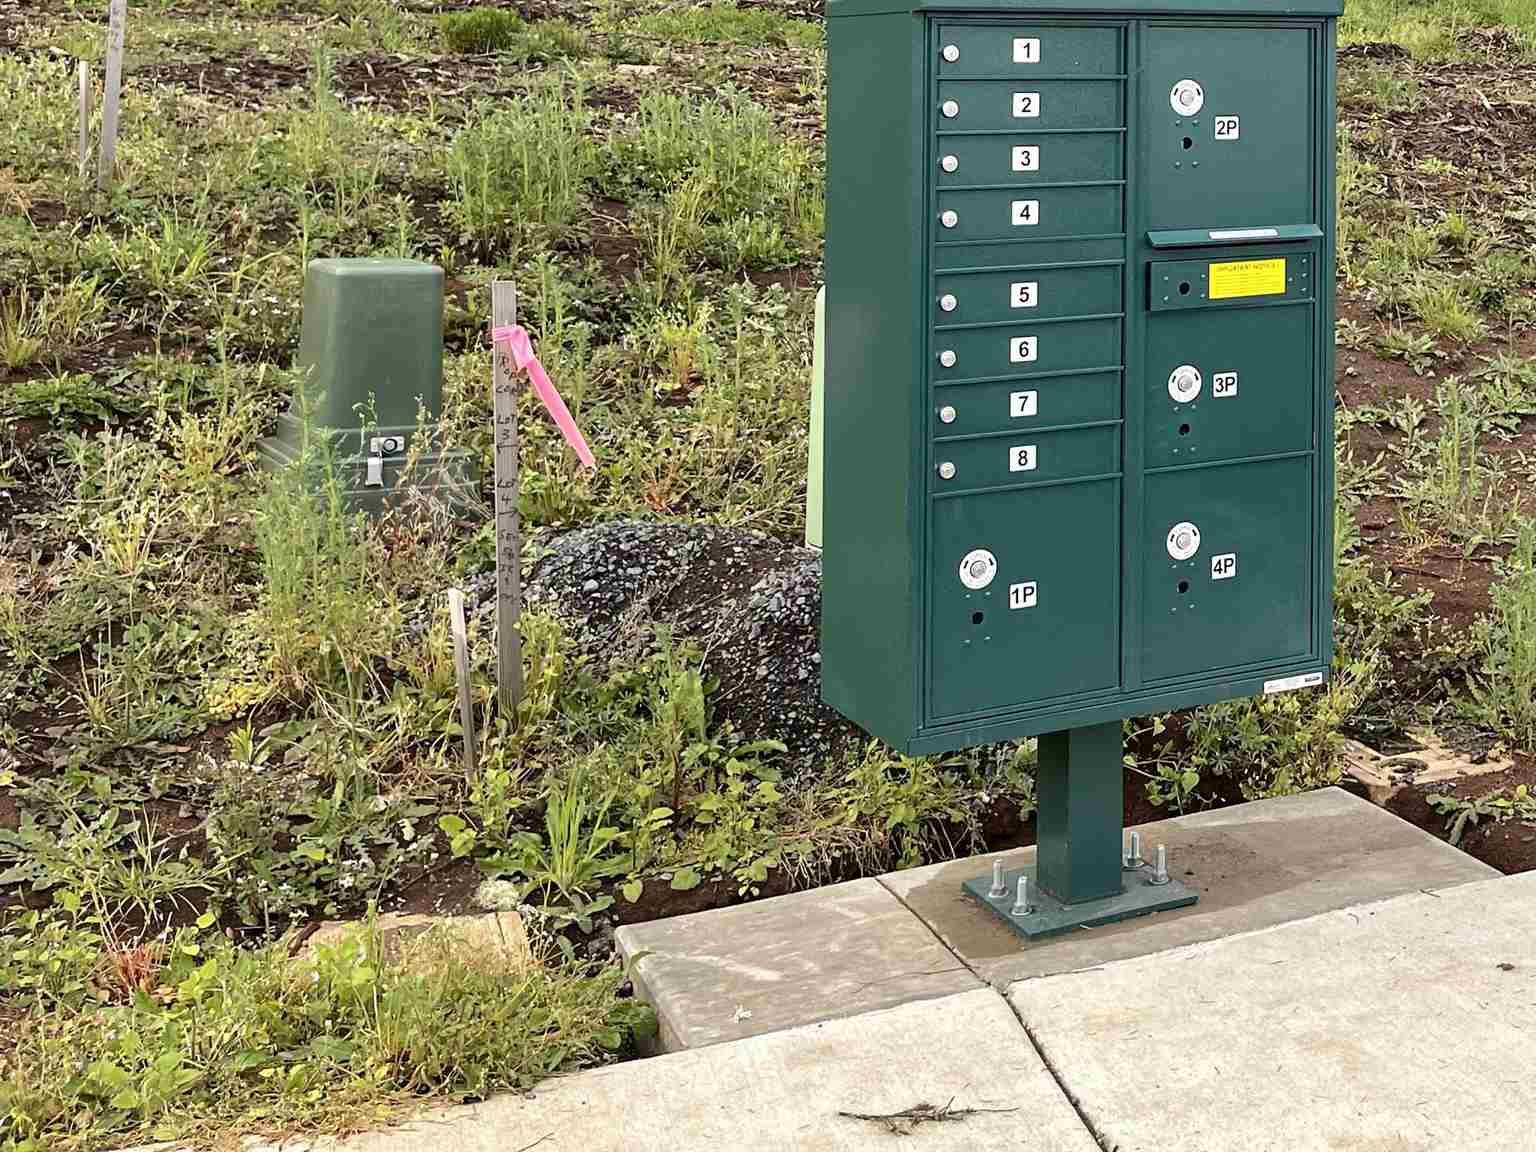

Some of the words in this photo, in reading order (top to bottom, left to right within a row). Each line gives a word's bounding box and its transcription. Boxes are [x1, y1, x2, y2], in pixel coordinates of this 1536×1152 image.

[1021, 96, 1032, 113] 2
[1216, 119, 1237, 136] 2P
[1020, 150, 1031, 167] 3
[1019, 204, 1031, 221] 4
[1018, 286, 1030, 303] 5
[1018, 340, 1029, 358] 6
[1215, 376, 1236, 393] 3P
[1018, 395, 1029, 412] 7
[1017, 450, 1028, 467] 8
[1213, 557, 1235, 575] 4P
[1011, 585, 1035, 604] 1P
